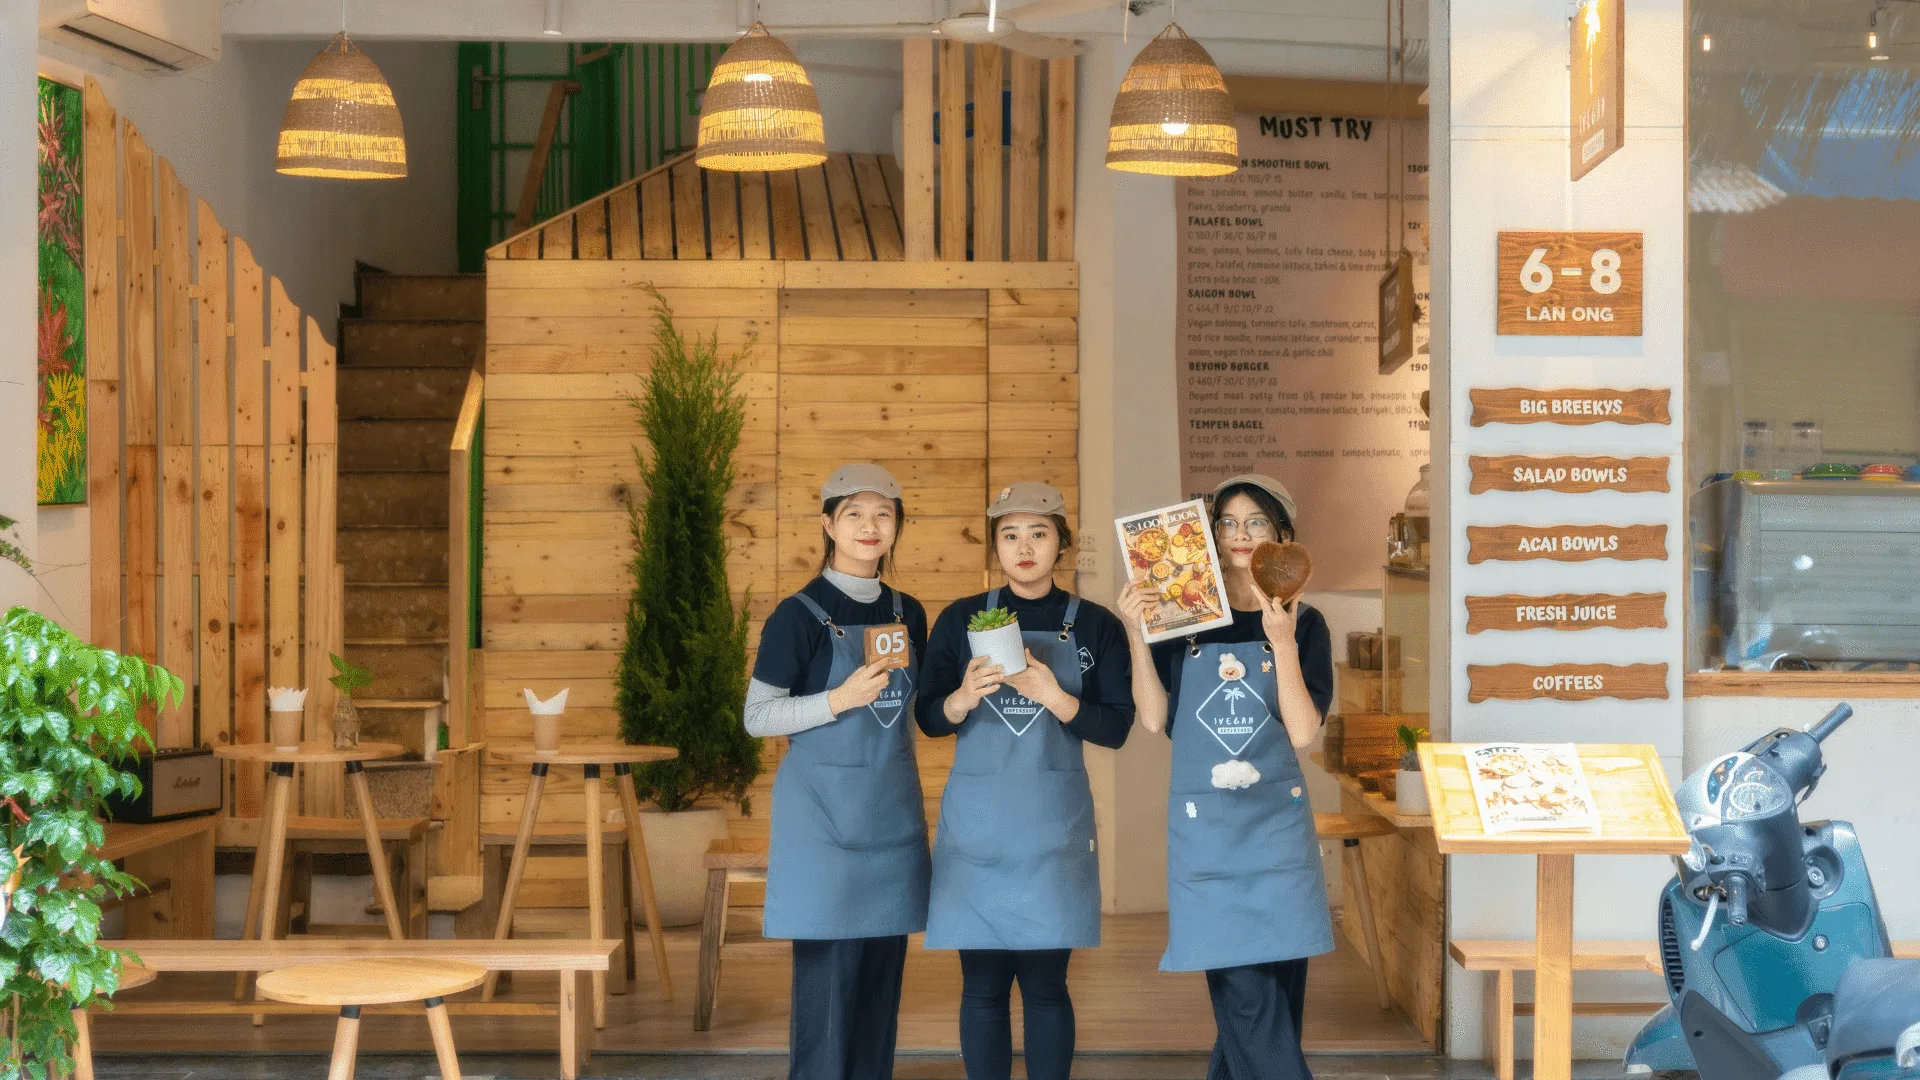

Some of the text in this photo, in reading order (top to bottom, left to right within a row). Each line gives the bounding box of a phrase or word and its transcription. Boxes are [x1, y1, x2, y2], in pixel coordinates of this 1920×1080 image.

[1260, 116, 1372, 142] MUST TRY
[1251, 159, 1301, 169] SMOOTHIE
[1304, 160, 1330, 170] BOWL
[1188, 187, 1205, 196] Blue
[1188, 216, 1263, 227] FALAFEL BOWL
[1285, 246, 1302, 256] tofu
[1188, 274, 1211, 284] Extra
[1188, 288, 1256, 299] SAIGON BOWL
[1526, 306, 1614, 322] LAN ONG
[1188, 318, 1212, 329] Vegan
[1204, 334, 1220, 342] rice
[1189, 362, 1269, 371] BEYOND BURGER
[1278, 391, 1298, 400] from
[1520, 399, 1623, 415] BIG BREEKYS
[1189, 420, 1264, 430] TEMPEH BAGEL
[1189, 450, 1215, 460] Vegan
[1513, 467, 1627, 483] SALAD BOWLS
[1518, 536, 1618, 553] ACAI BOWLS
[1516, 605, 1616, 622] FRESH JUICE
[876, 631, 905, 655] 05
[1533, 675, 1604, 691] COFFEES
